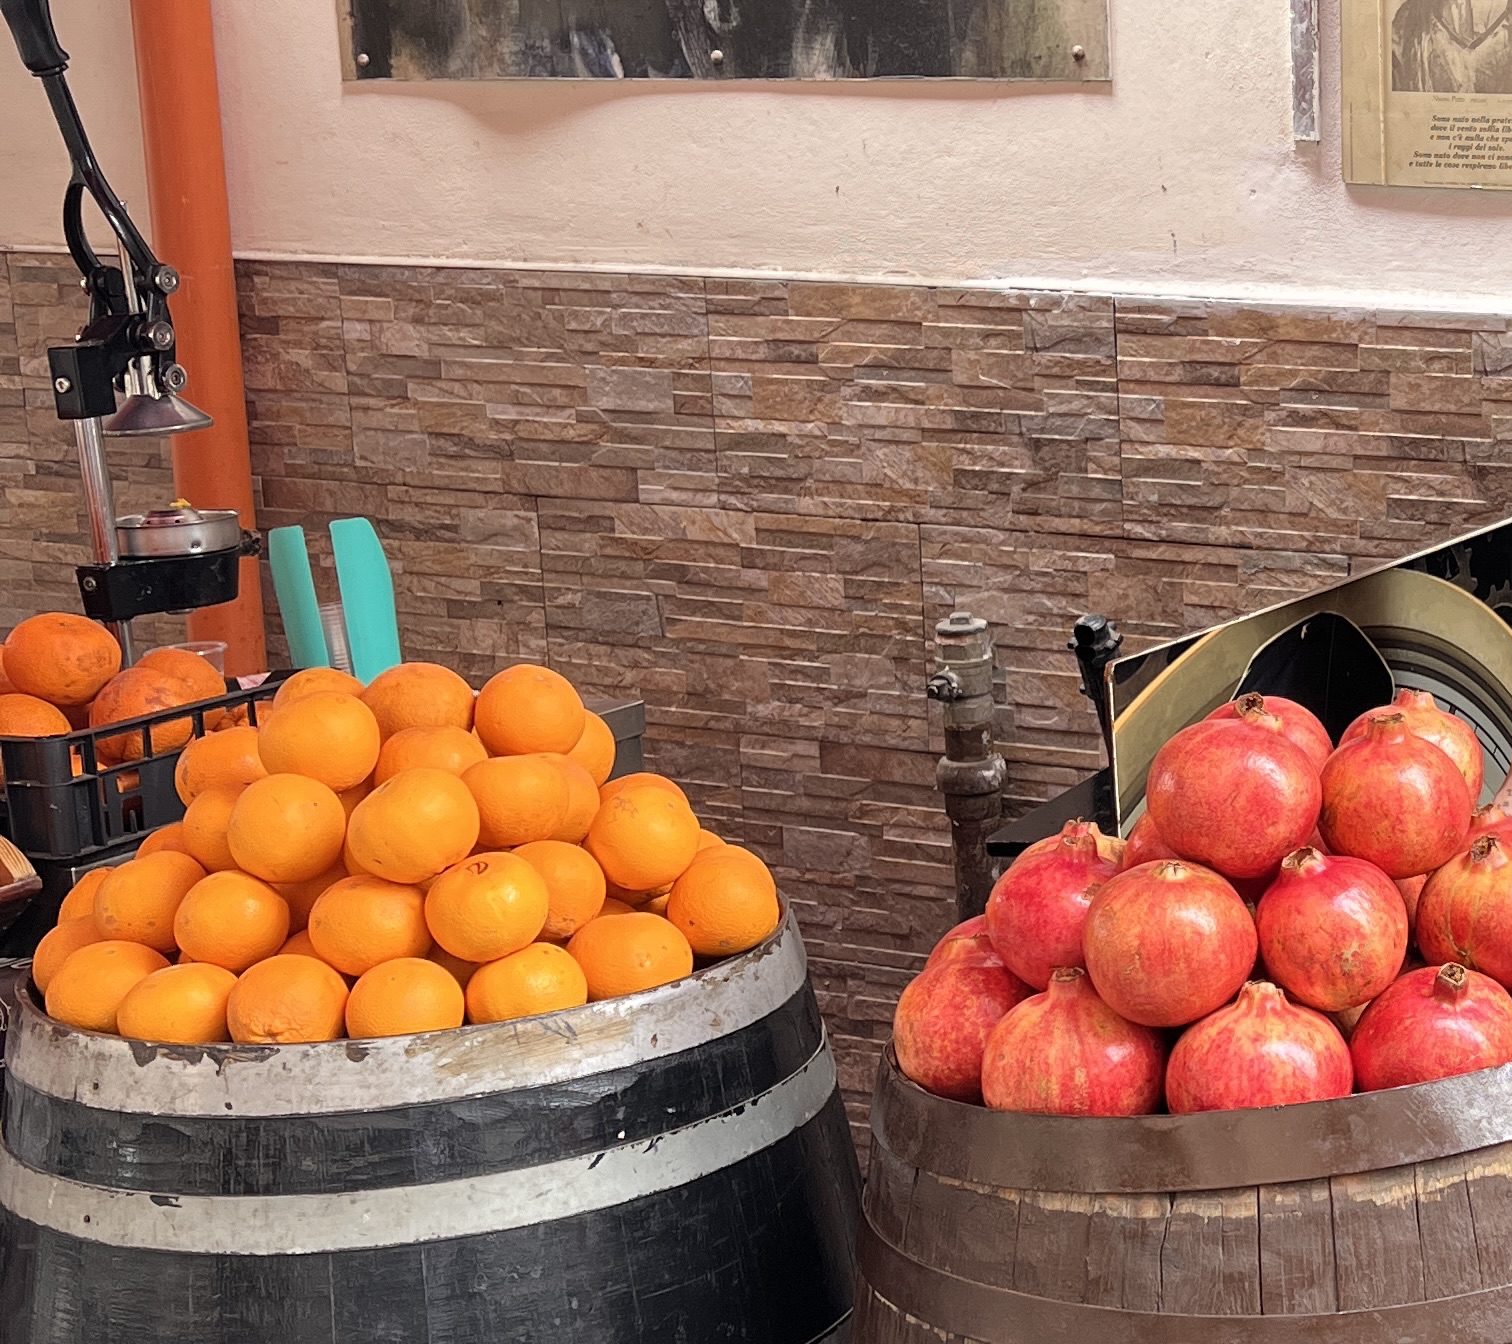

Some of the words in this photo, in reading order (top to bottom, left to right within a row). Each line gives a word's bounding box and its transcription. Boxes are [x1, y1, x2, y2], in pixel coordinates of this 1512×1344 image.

[1479, 125, 1500, 133] soffia
[1453, 143, 1473, 153] raggi
[1474, 143, 1487, 151] del
[1413, 150, 1432, 158] Sono
[1435, 160, 1442, 168] le
[1461, 162, 1498, 170] respirano
